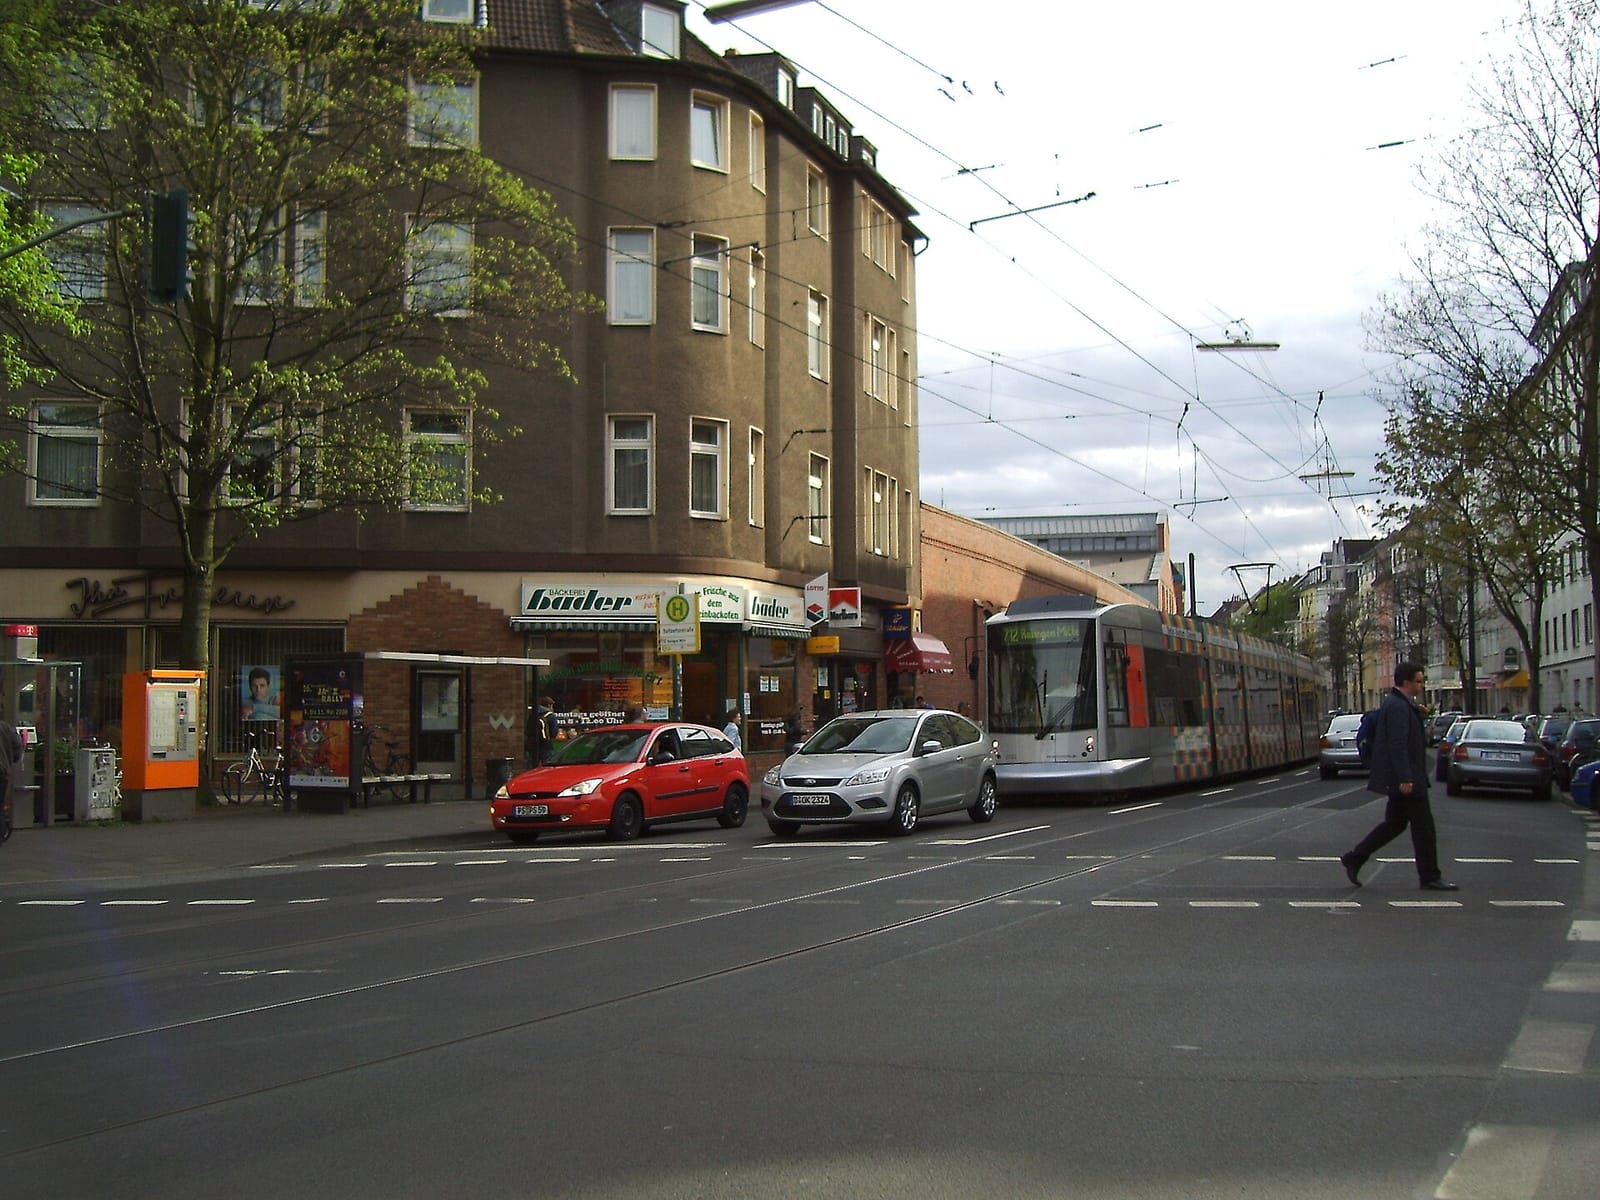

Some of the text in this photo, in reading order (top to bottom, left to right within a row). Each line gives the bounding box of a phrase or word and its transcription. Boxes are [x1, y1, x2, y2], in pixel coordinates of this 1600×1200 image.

[526, 588, 633, 611] bader
[702, 586, 740, 604] Frische aus
[707, 599, 723, 608] dem
[321, 695, 345, 703] RALLY
[553, 710, 625, 719] onntags geöffnet
[581, 717, 604, 725] 12.00
[605, 717, 624, 725] Uhr
